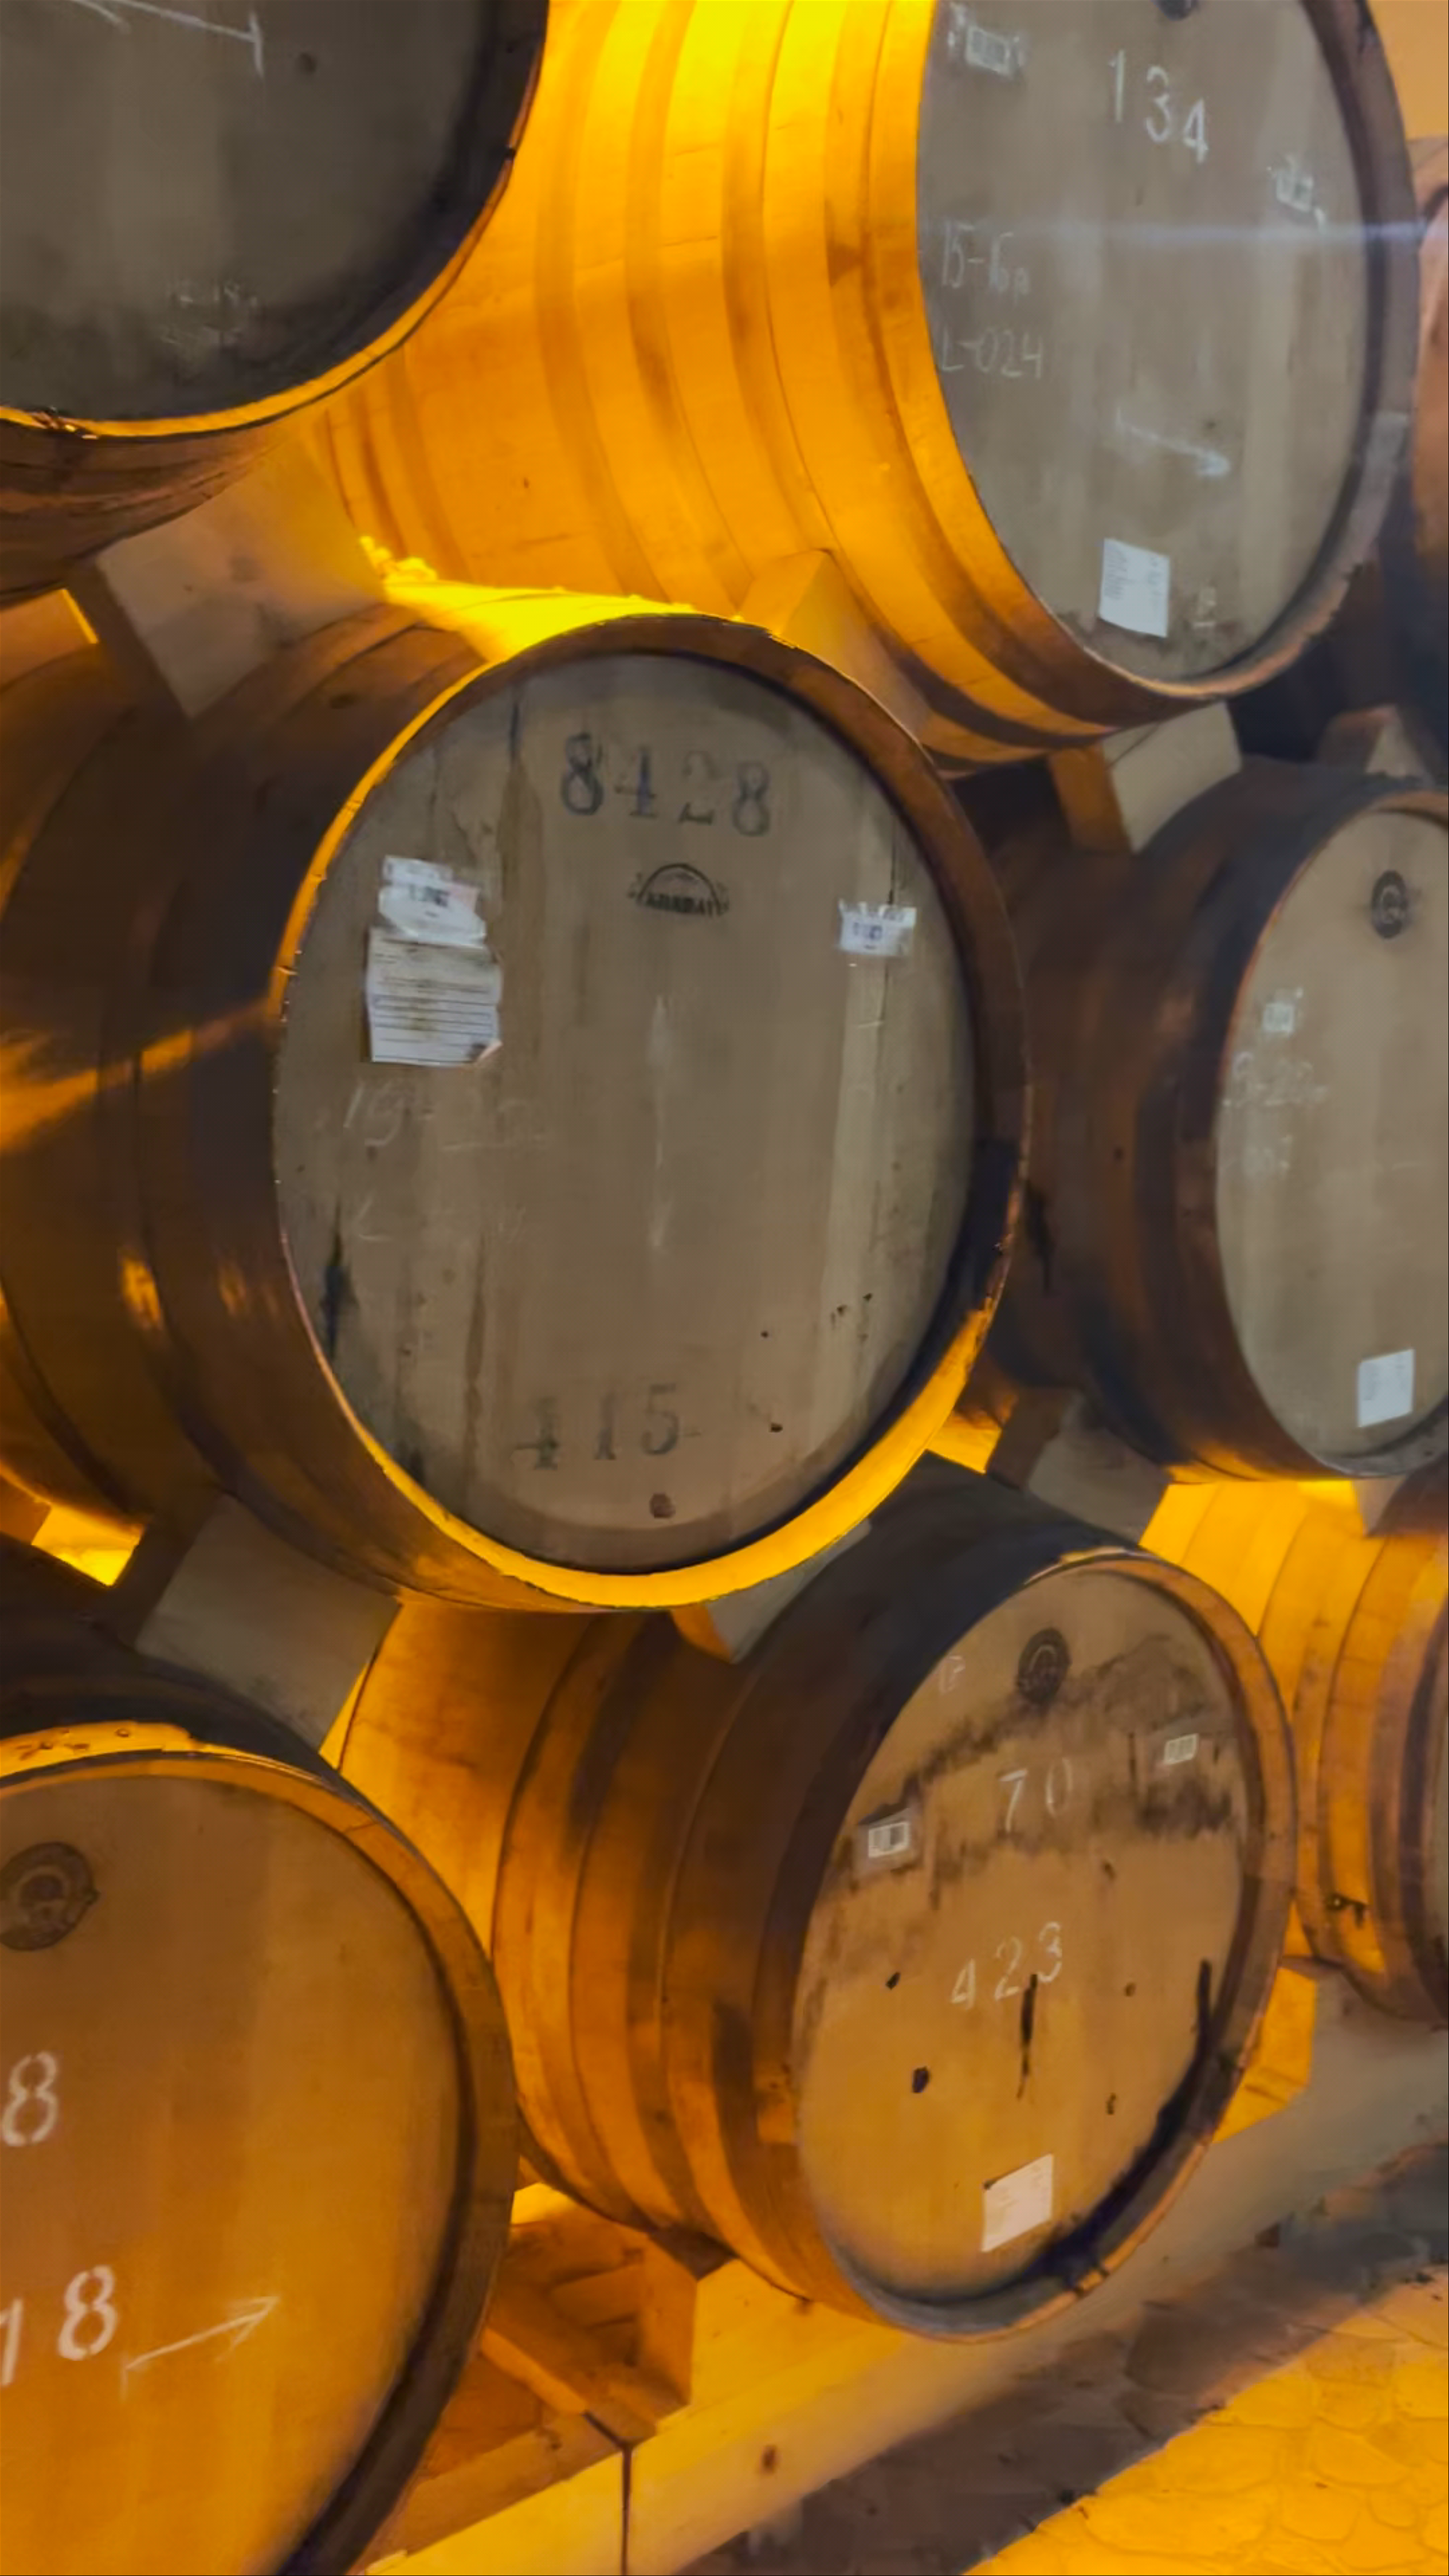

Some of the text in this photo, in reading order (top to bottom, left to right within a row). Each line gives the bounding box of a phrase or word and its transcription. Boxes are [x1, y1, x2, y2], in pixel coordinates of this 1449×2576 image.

[1107, 48, 1210, 164] 134
[561, 731, 771, 837] 8428
[1000, 1757, 1073, 1833] 70
[950, 1921, 1063, 2010] 423
